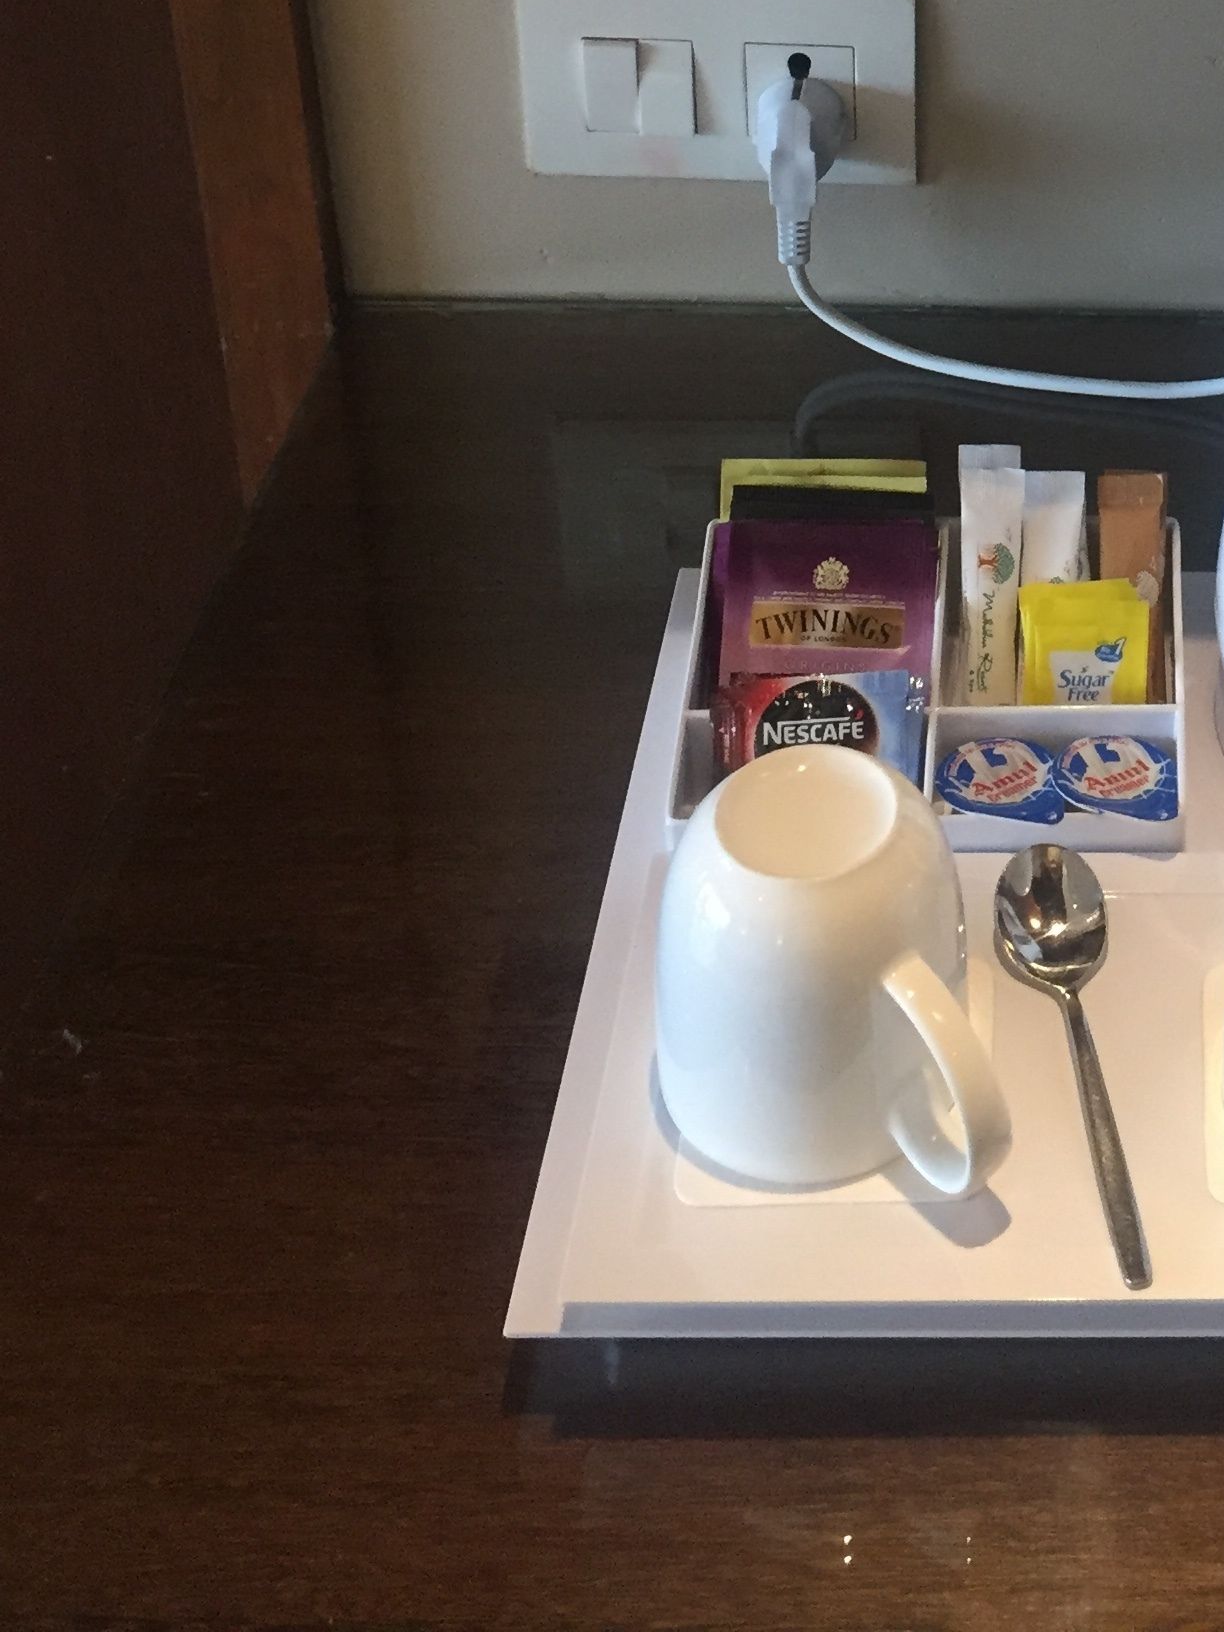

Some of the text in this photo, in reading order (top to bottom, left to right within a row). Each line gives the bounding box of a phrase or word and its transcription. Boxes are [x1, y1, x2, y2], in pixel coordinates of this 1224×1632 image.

[755, 608, 894, 644] TWININGS
[1058, 669, 1110, 689] Sugar
[1067, 688, 1099, 702] Free
[971, 761, 1038, 796] Amul
[1084, 759, 1151, 791] Amul
